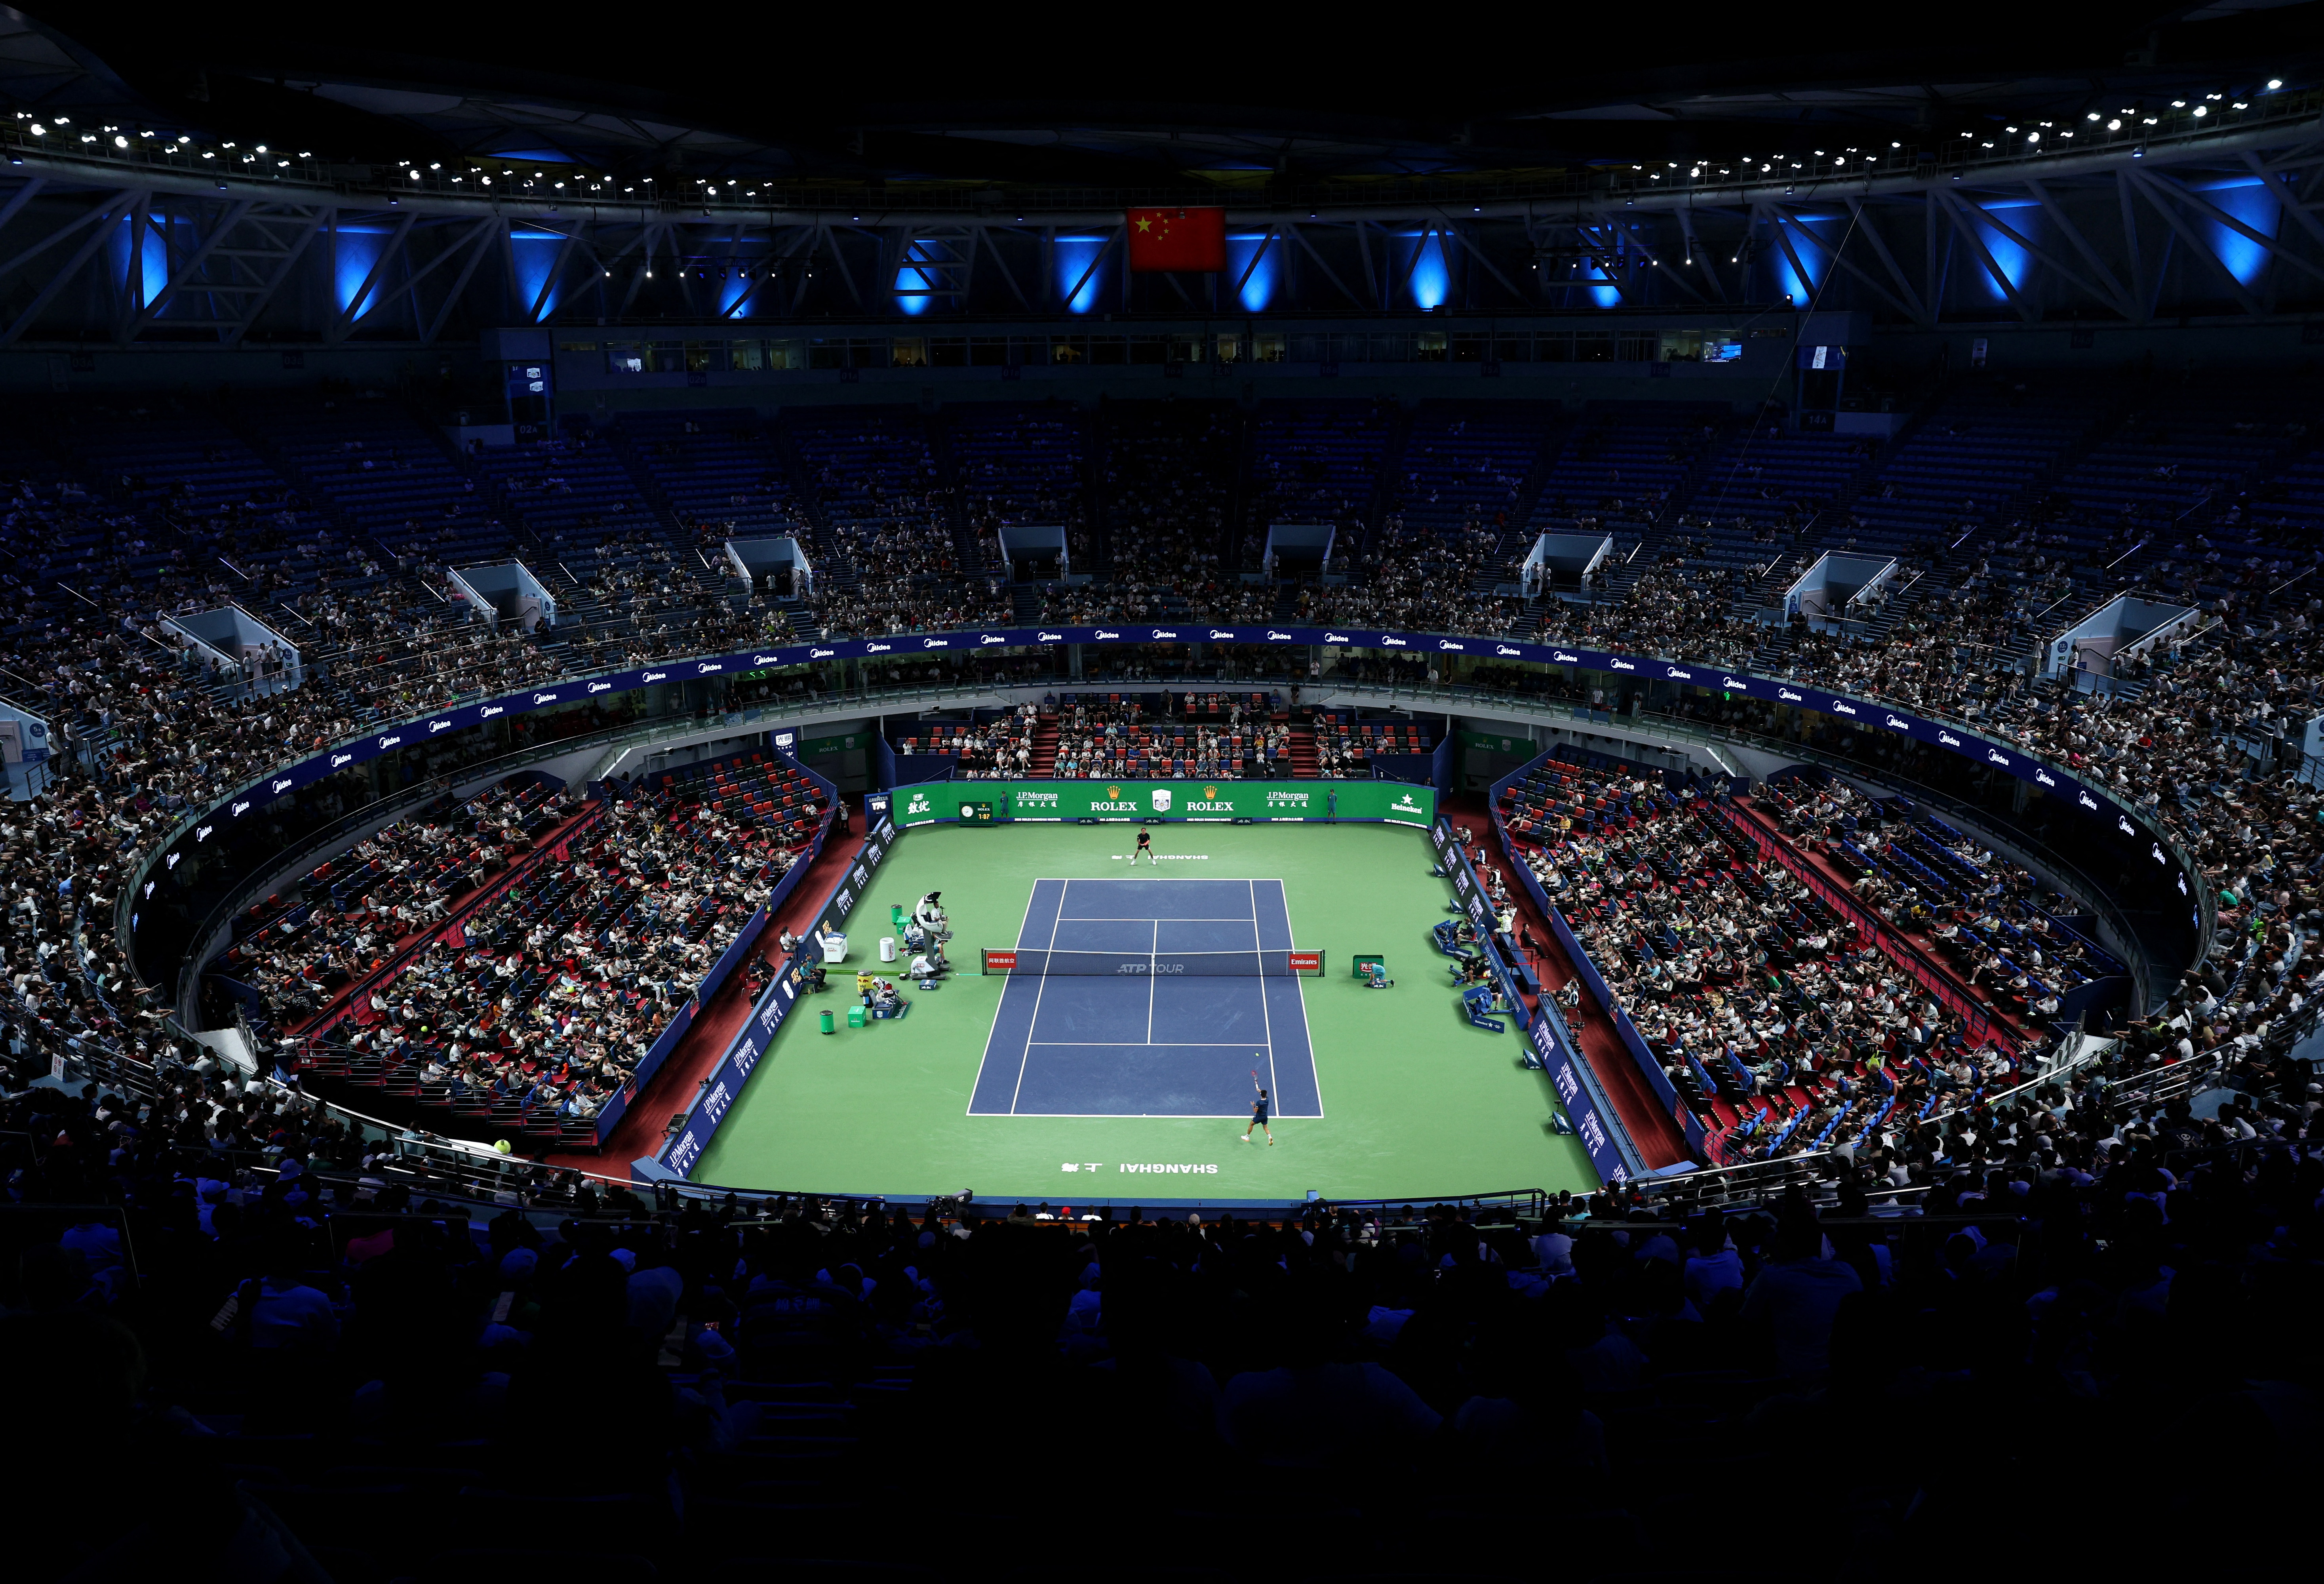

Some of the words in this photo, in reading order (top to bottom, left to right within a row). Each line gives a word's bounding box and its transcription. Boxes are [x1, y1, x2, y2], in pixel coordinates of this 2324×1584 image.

[1809, 415, 1826, 425] 14A
[981, 634, 1005, 644] Midea
[1038, 632, 1062, 641] Midea
[1095, 630, 1119, 640] Midea
[1152, 629, 1176, 639] Midea
[1210, 630, 1234, 639] Midea
[1267, 630, 1291, 640] Midea
[1325, 633, 1349, 642] Midea
[924, 638, 948, 648] Midea
[1382, 636, 1406, 645] Midea
[1439, 640, 1464, 650] Midea
[810, 648, 834, 658] Midea
[867, 643, 891, 653] Midea
[1496, 645, 1521, 655] Midea
[754, 655, 777, 665] Midea
[1553, 651, 1578, 662] Midea
[698, 663, 722, 673] Midea
[1610, 658, 1634, 670] Midea
[642, 672, 666, 682] Midea
[1667, 666, 1691, 679] Midea
[588, 682, 611, 693] Midea
[1723, 676, 1746, 689] Midea
[533, 693, 557, 704] Midea
[1779, 687, 1802, 701] Midea
[480, 706, 503, 718] Midea
[1833, 700, 1856, 715] Midea
[429, 721, 451, 733] Midea
[1886, 714, 1909, 730] Midea
[379, 737, 400, 749] Midea
[1939, 730, 1960, 747] Midea
[331, 754, 352, 767] Midea
[1988, 748, 2009, 766] Midea
[2036, 768, 2055, 787] Midea
[272, 779, 292, 794] Midea
[1016, 792, 1058, 801] J.P.Morgan
[1266, 792, 1309, 801] J.P.Morgan
[2079, 790, 2097, 810] Midea
[232, 801, 249, 817] Midea
[872, 801, 886, 811] 176
[908, 800, 930, 814] 致优
[1091, 802, 1137, 811] ROLEX
[1187, 802, 1234, 811] ROLEX
[1391, 803, 1422, 814] Heineken
[2119, 815, 2134, 836] Midea
[196, 825, 212, 842] Midea
[2152, 842, 2165, 865] Midea
[167, 852, 180, 870] Midea
[1117, 964, 1147, 973] ATP
[1503, 980, 1513, 1000] SHANGHAI
[1511, 996, 1521, 1013] MASTERS
[760, 999, 778, 1026] J.P.Morgan
[1539, 1020, 1555, 1050] J.P.Morgan
[733, 1038, 753, 1067] J.P.Morgan
[1561, 1062, 1578, 1095] J.P.Morgan
[703, 1081, 725, 1114] J.P.Morgan
[1585, 1109, 1605, 1146] J.P.Morgan
[669, 1131, 694, 1167] J.P.Morgan
[1061, 1163, 1103, 1173] 上海
[1120, 1163, 1218, 1174] SHANGHAI
[1614, 1163, 1627, 1182] J.P.M
